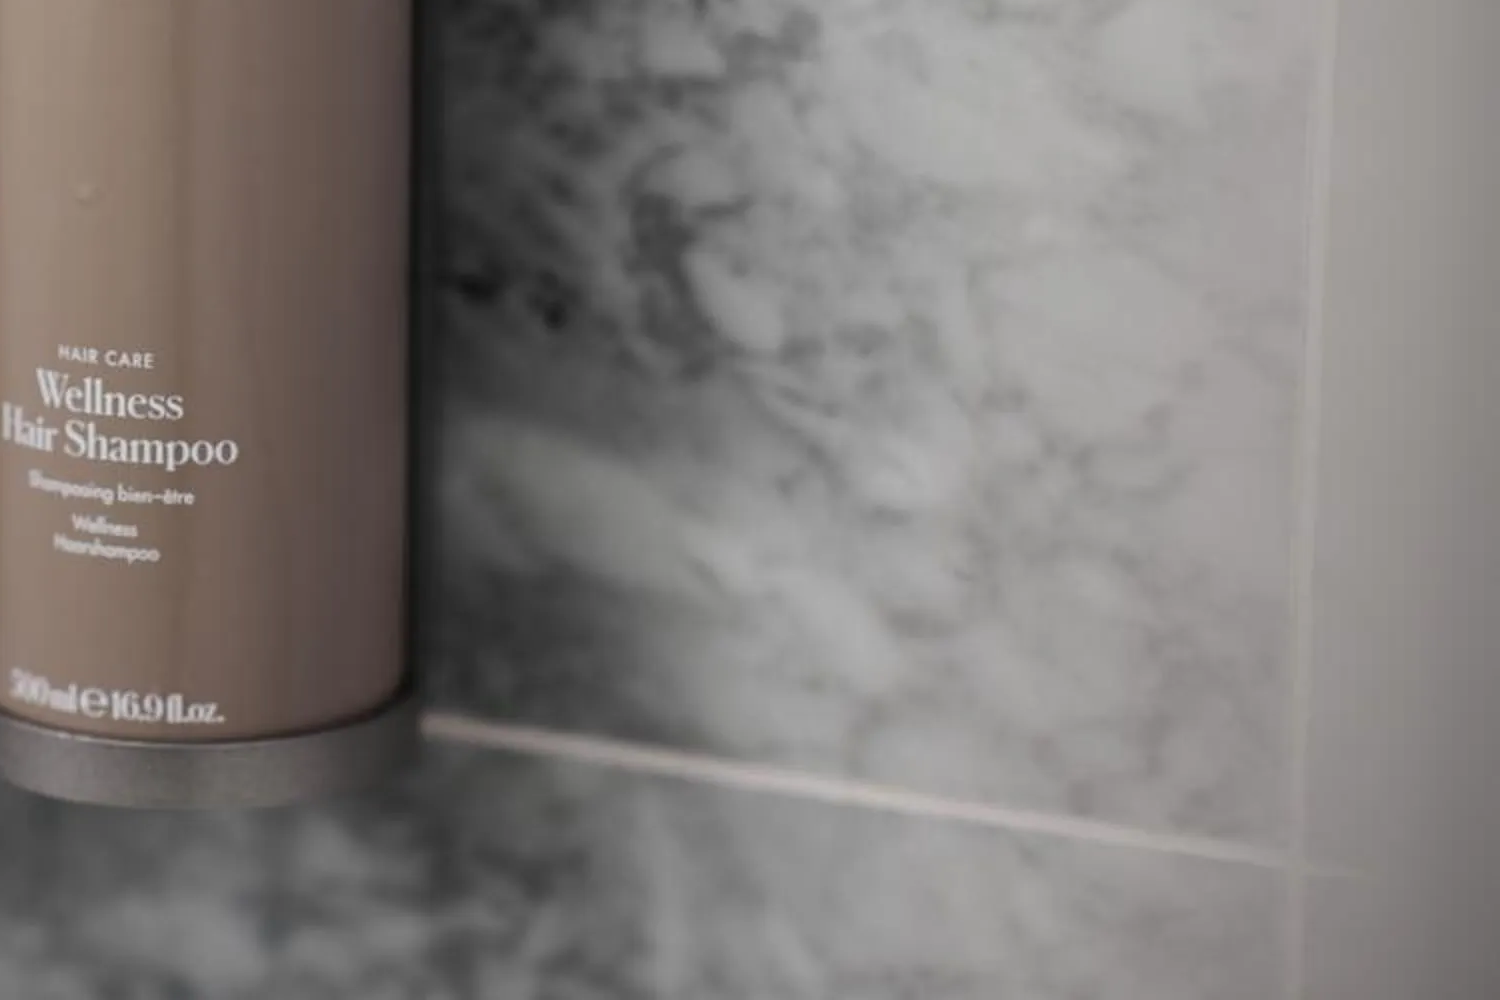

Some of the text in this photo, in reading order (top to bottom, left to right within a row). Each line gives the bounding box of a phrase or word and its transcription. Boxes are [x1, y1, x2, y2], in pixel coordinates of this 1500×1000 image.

[57, 344, 155, 370] HAIR CARE
[36, 367, 185, 421] Wellness
[2, 401, 239, 472] Hair Shampoo
